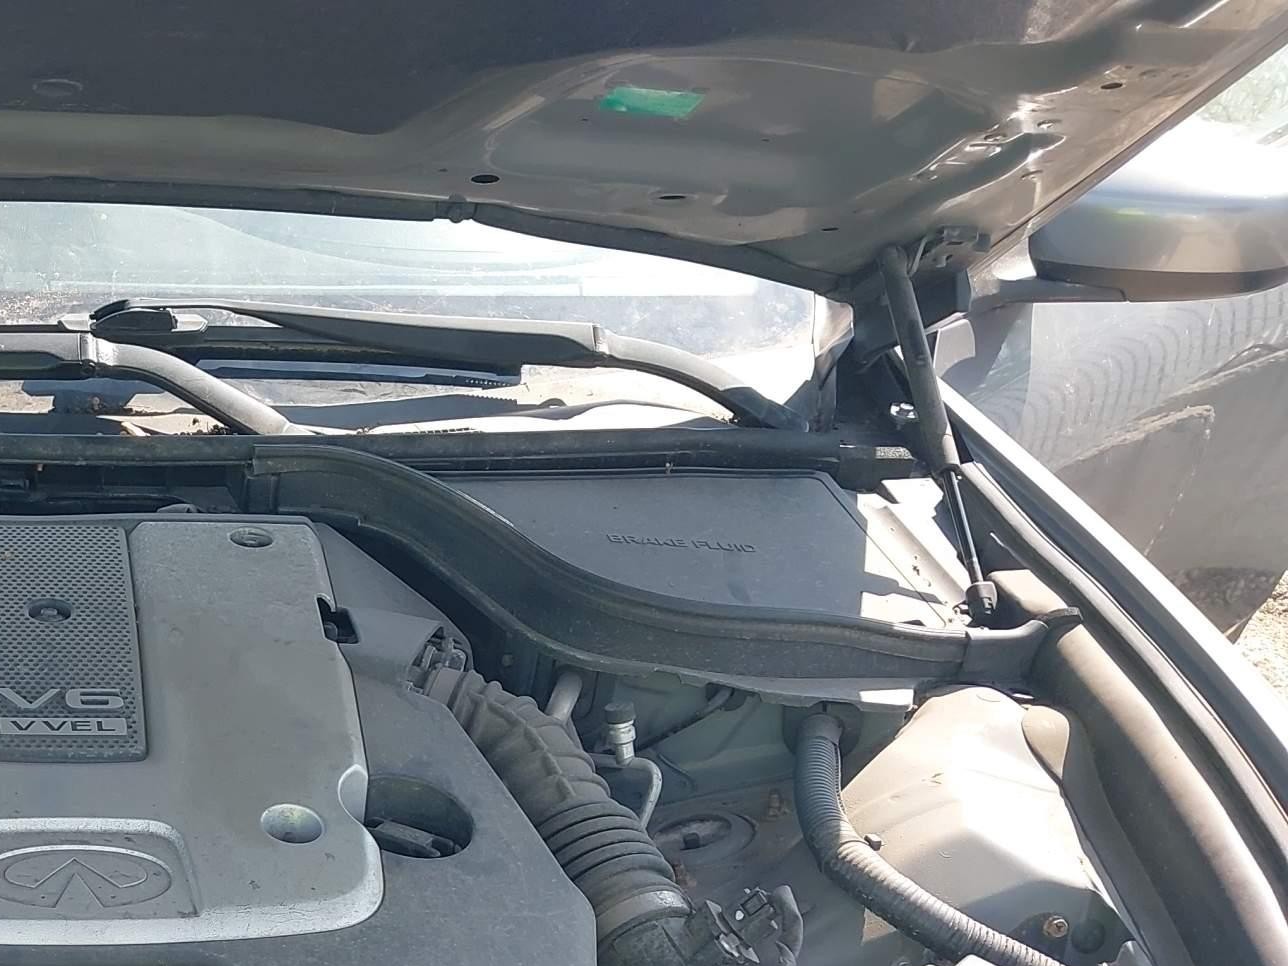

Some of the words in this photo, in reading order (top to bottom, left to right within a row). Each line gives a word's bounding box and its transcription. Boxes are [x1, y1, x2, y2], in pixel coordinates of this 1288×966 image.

[606, 533, 689, 548] BRAKE
[691, 539, 756, 553] FLUID
[10, 720, 116, 732] VVEL
